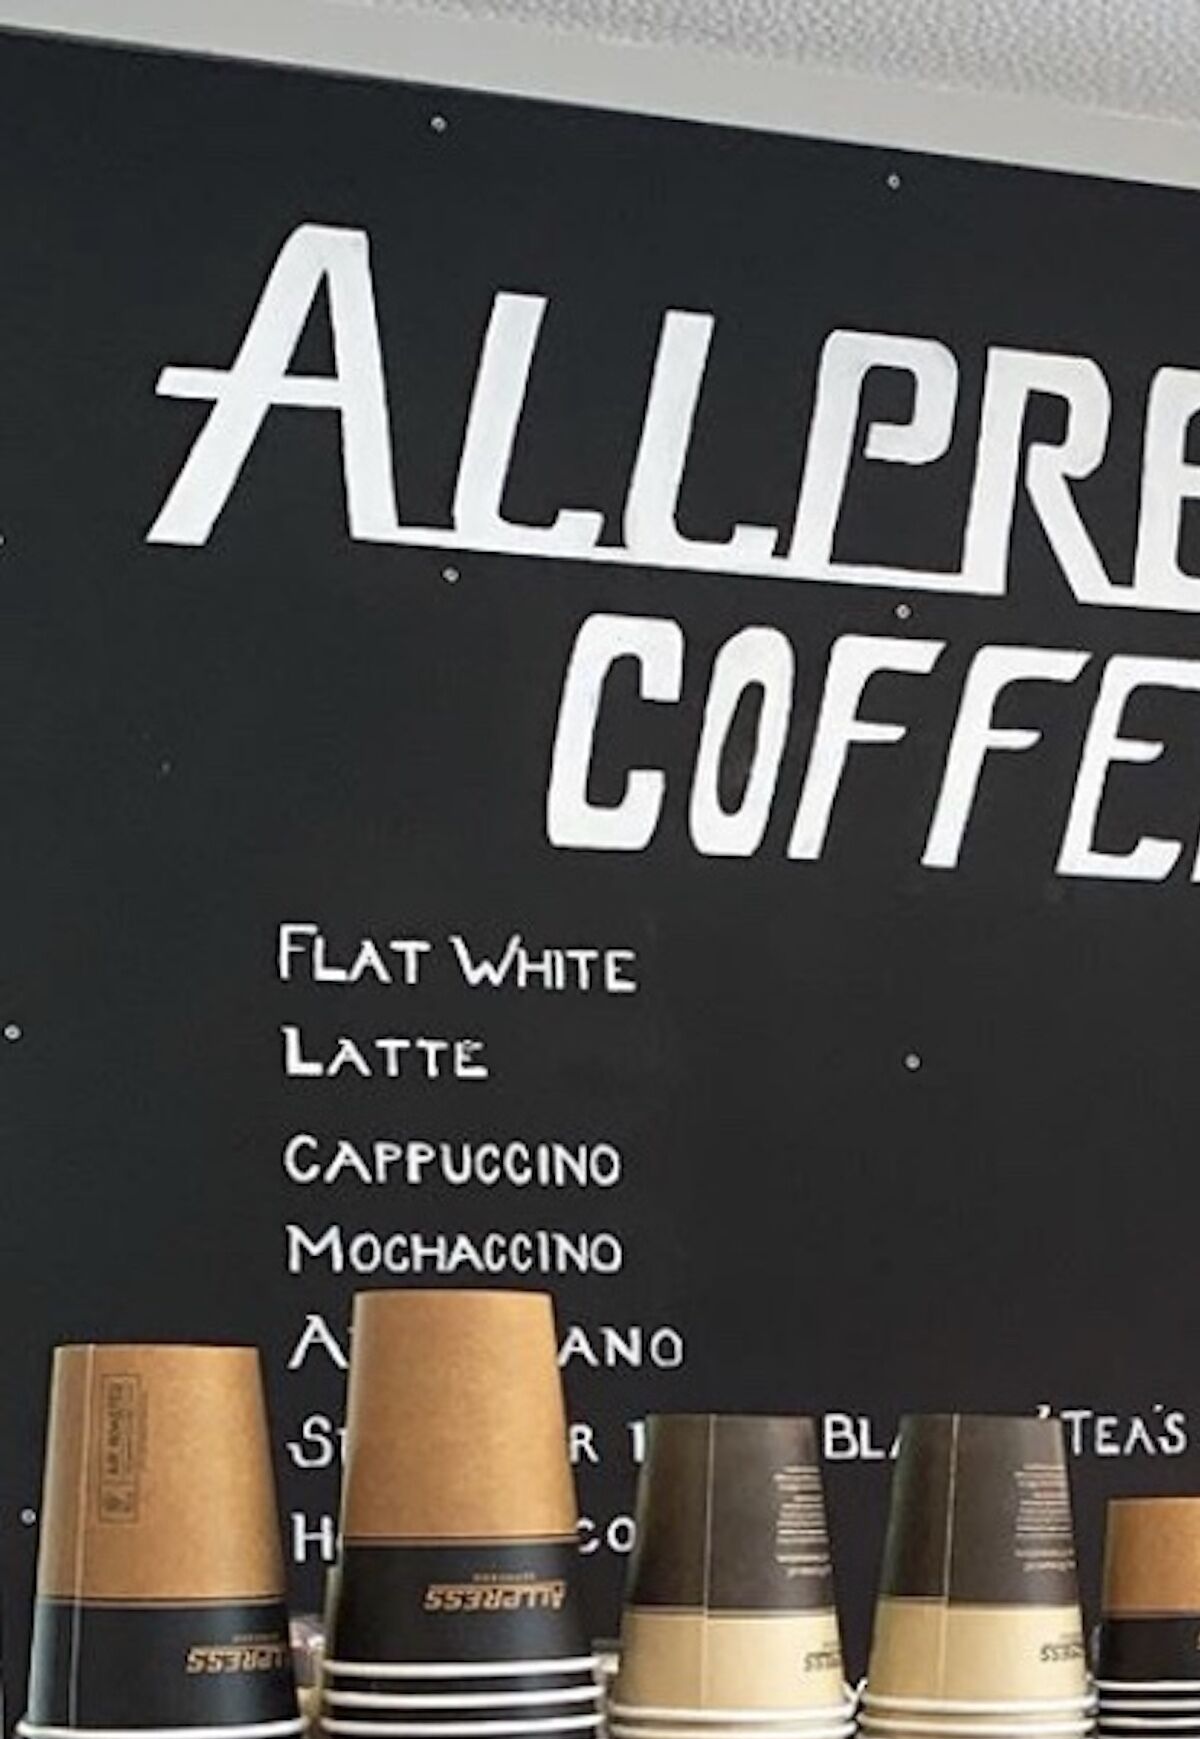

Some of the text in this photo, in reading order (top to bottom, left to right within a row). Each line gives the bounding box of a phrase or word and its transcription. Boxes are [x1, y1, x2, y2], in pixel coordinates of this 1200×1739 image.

[278, 923, 638, 993] FLAT WHITE
[280, 1025, 490, 1079] LATTE
[283, 1134, 622, 1187] CAPPUCCINO
[286, 1224, 623, 1274] MOCHACCINO
